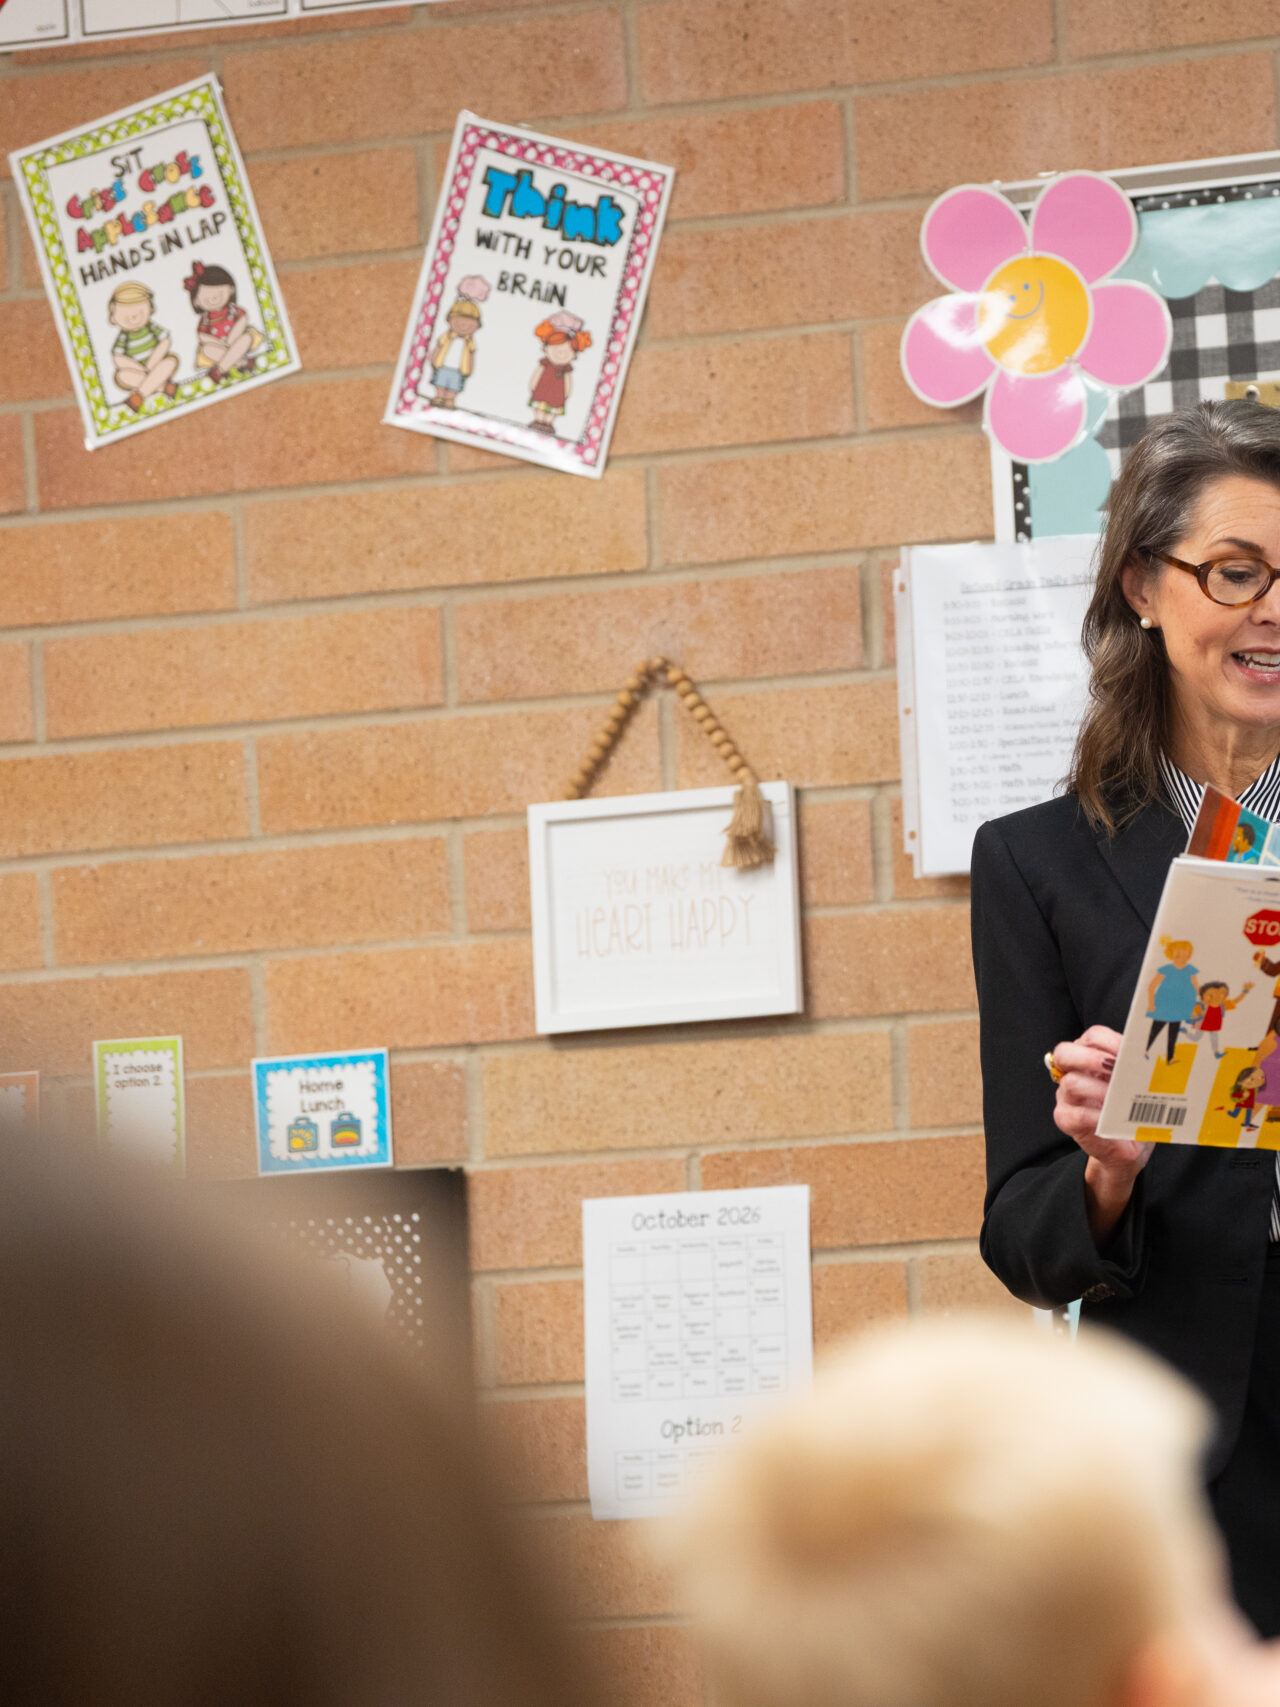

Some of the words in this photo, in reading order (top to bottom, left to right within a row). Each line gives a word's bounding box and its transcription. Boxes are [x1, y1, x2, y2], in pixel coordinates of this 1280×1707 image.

[481, 165, 626, 247] Think
[79, 240, 156, 286] HANDS
[187, 211, 227, 244] LAP
[543, 246, 608, 278] YOUR
[299, 1079, 344, 1094] Home
[300, 1096, 345, 1113] Lunch
[631, 1208, 711, 1232] October
[716, 1205, 762, 1227] 2026
[660, 1417, 725, 1444] Option
[731, 1415, 744, 1434] 2
